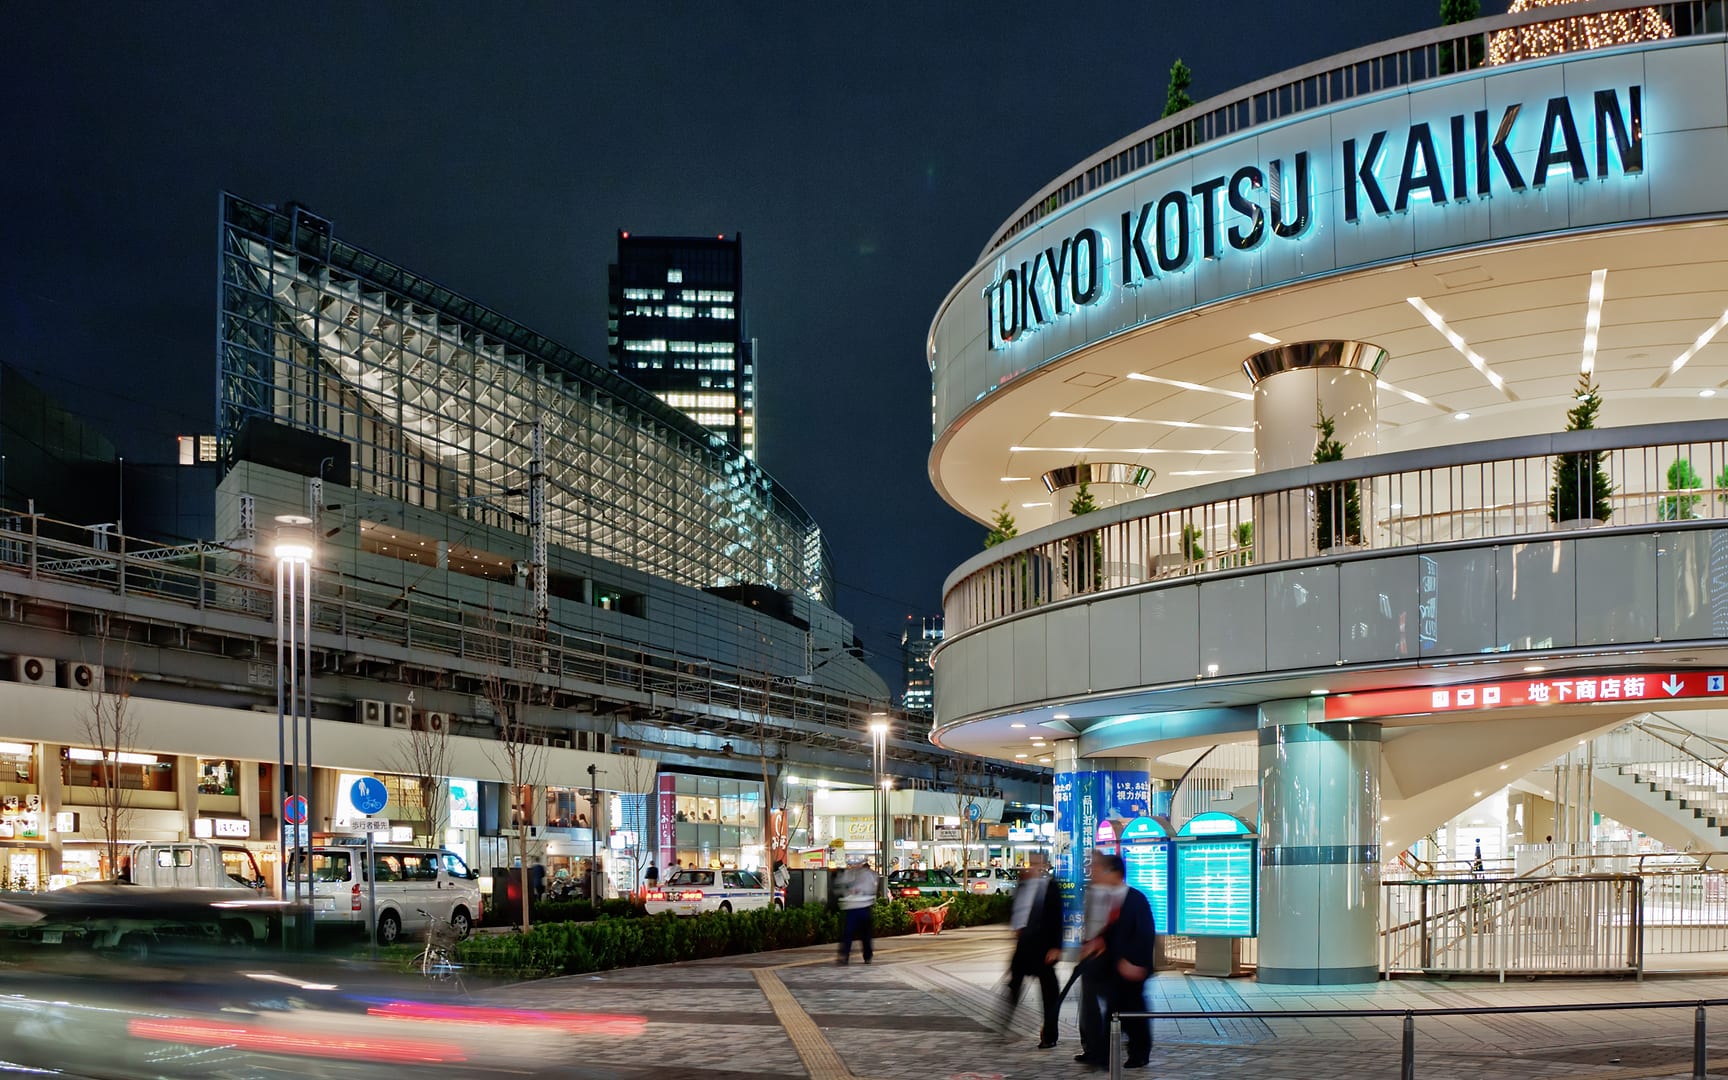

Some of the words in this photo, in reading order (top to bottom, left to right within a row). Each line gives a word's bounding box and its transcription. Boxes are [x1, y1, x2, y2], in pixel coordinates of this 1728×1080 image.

[982, 227, 1100, 351] TOKYO
[1121, 151, 1312, 288] KOTSU
[1343, 85, 1645, 224] KAIKAN
[1528, 677, 1646, 702] 地下商店街
[352, 821, 388, 830] 歩行者優先
